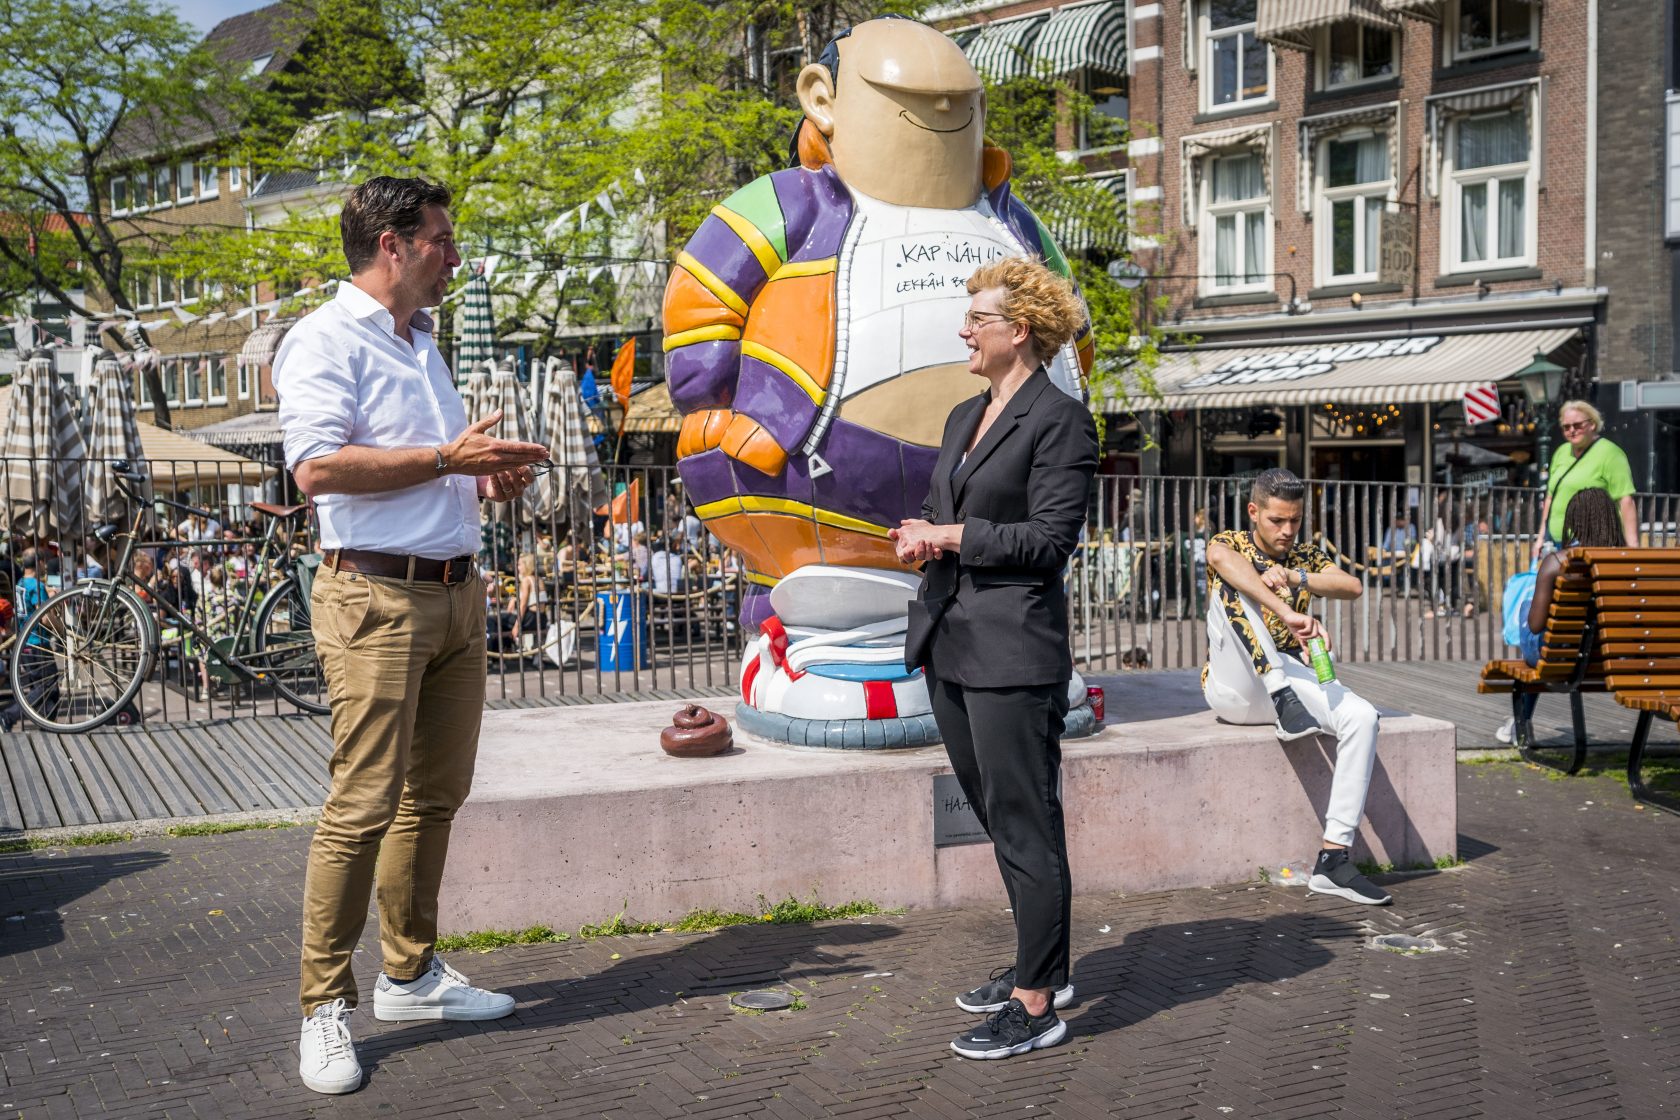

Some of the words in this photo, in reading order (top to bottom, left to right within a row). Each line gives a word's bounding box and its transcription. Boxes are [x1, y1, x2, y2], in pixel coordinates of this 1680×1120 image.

[901, 244, 941, 263] KAP
[946, 241, 982, 264] NÂH
[1382, 248, 1412, 272] HOP
[896, 272, 945, 293] LEKKÂH
[951, 276, 967, 288] BE
[1213, 335, 1443, 373] HOENDER
[1219, 363, 1334, 386] HOP
[945, 796, 971, 813] HAA
